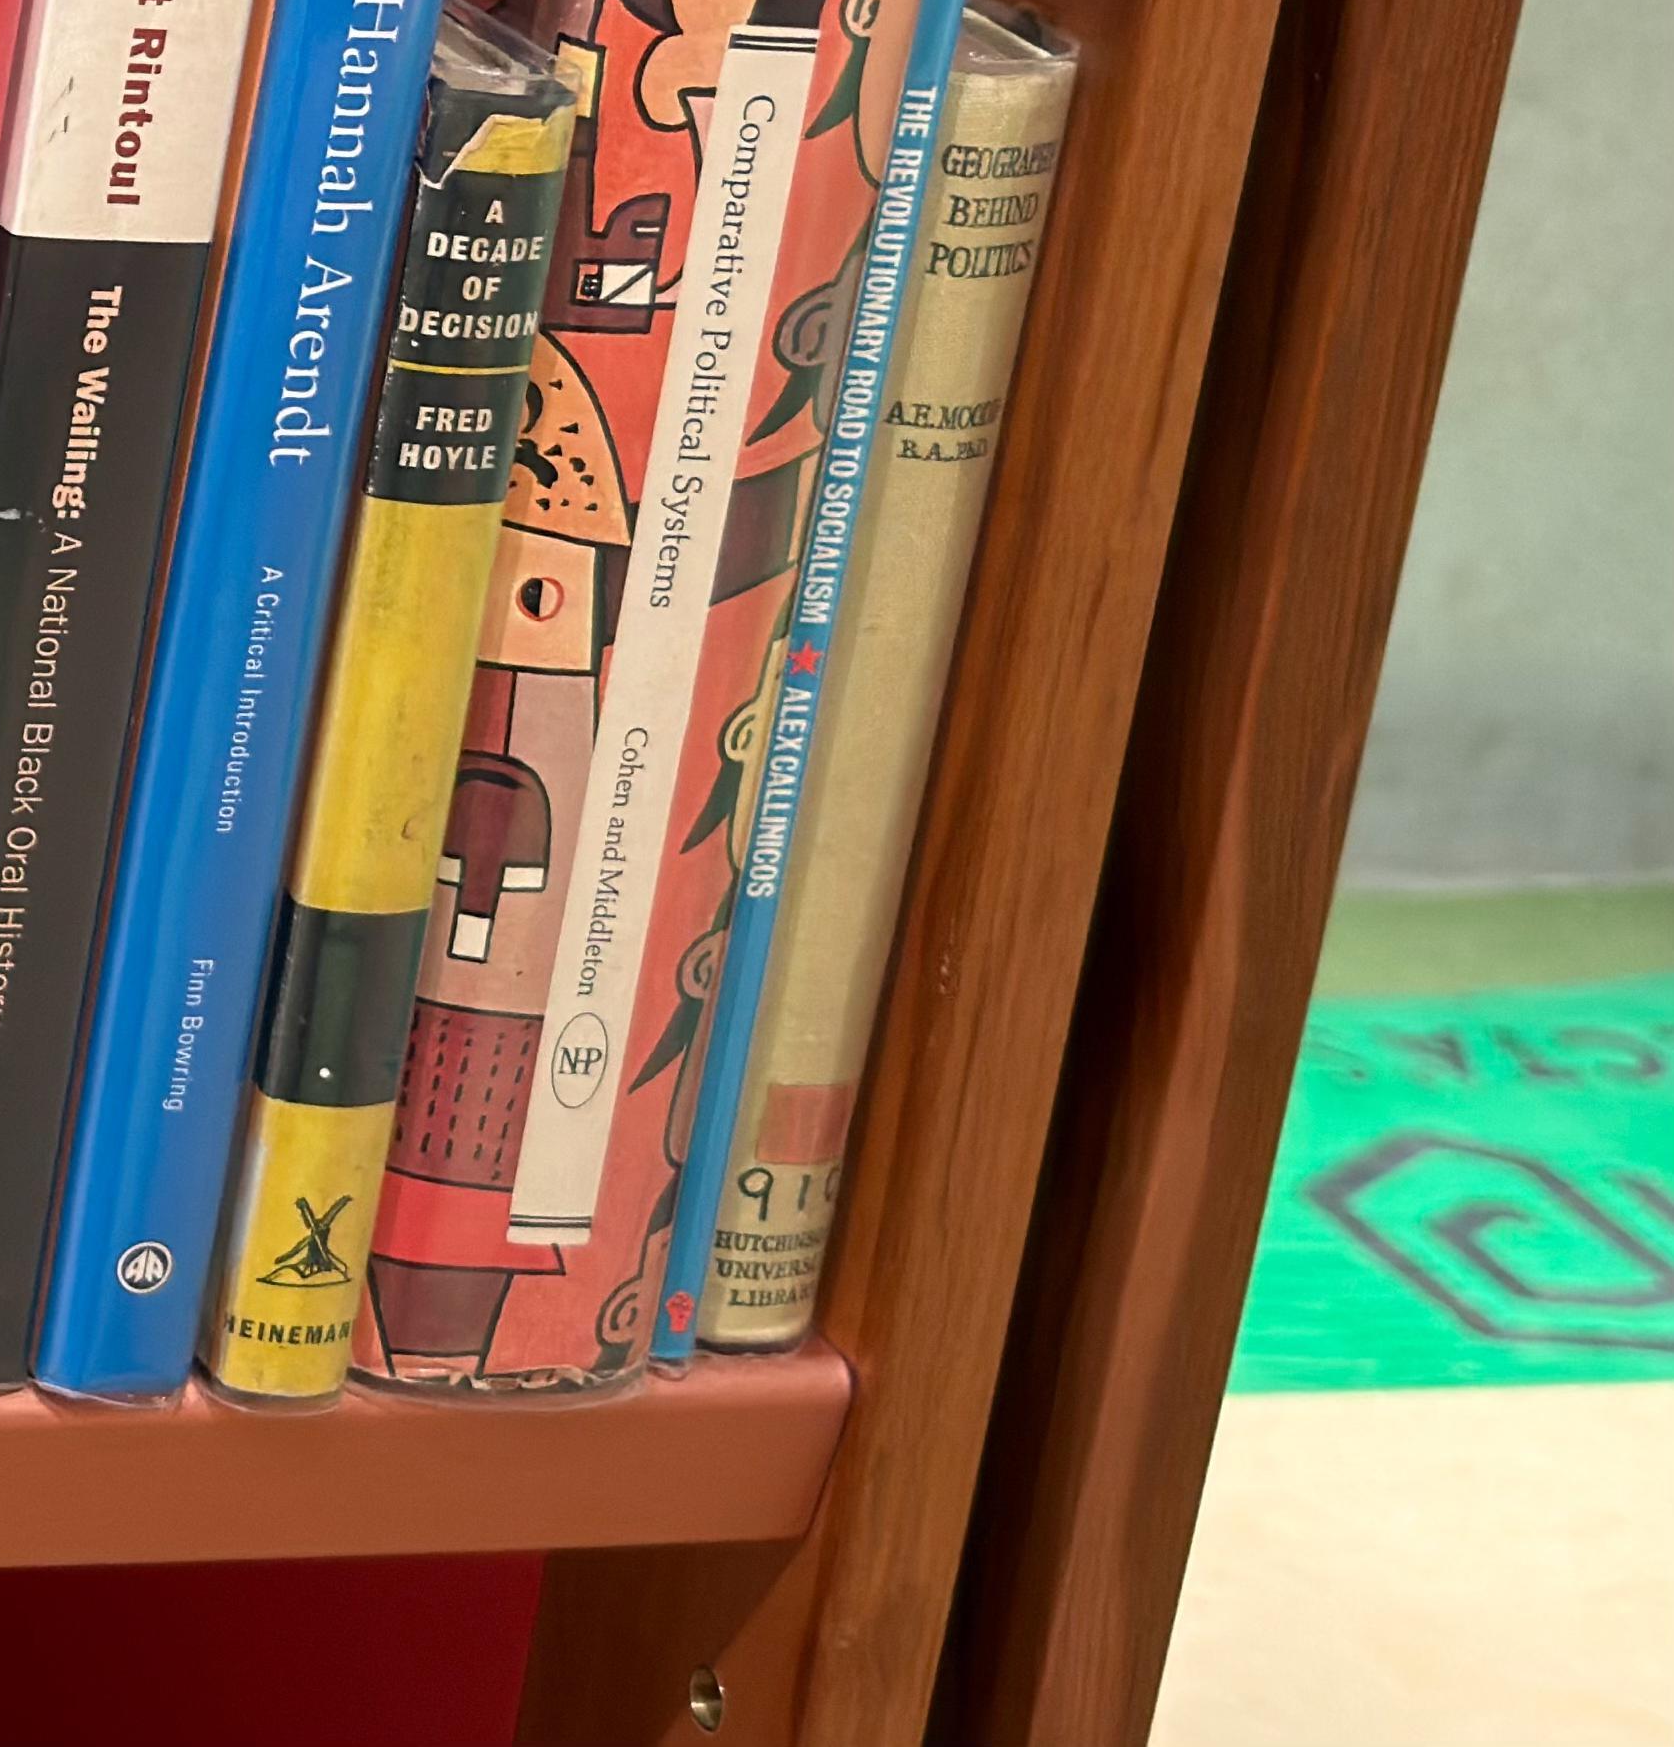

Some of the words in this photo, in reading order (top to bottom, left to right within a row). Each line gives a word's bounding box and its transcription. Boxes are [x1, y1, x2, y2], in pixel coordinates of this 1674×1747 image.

[106, 28, 167, 205] Rintoul
[898, 87, 938, 138] THE
[485, 199, 504, 224] A
[701, 93, 776, 318] Comparative
[943, 192, 1039, 227] BEHIND
[427, 231, 544, 263] DECADE
[852, 155, 921, 363] REVOLUTIONARY
[82, 286, 123, 354] The
[400, 304, 538, 340] DECISION
[462, 276, 501, 302] OF
[270, 255, 352, 467] Arendt
[681, 318, 734, 461] Political
[51, 365, 110, 521] Wailing:
[415, 405, 494, 433] FRED
[834, 370, 876, 447] ROAD
[399, 442, 496, 471] HOYLE
[829, 447, 864, 484] TO
[50, 533, 82, 557] A
[260, 565, 282, 585] A
[649, 470, 705, 610] Systems
[799, 483, 851, 625] SOCIALISM
[27, 567, 78, 712] National
[236, 593, 277, 681] Critical
[773, 686, 812, 753] ALEX
[10, 722, 56, 815] Black
[214, 686, 262, 835] Introduction
[609, 726, 649, 809] Cohen
[0, 824, 38, 900] Oral
[599, 816, 628, 867] and
[746, 755, 799, 899] CALLINICOS
[576, 869, 626, 996] Middleton
[188, 957, 215, 1009] Finn
[163, 1014, 205, 1113] Bowring
